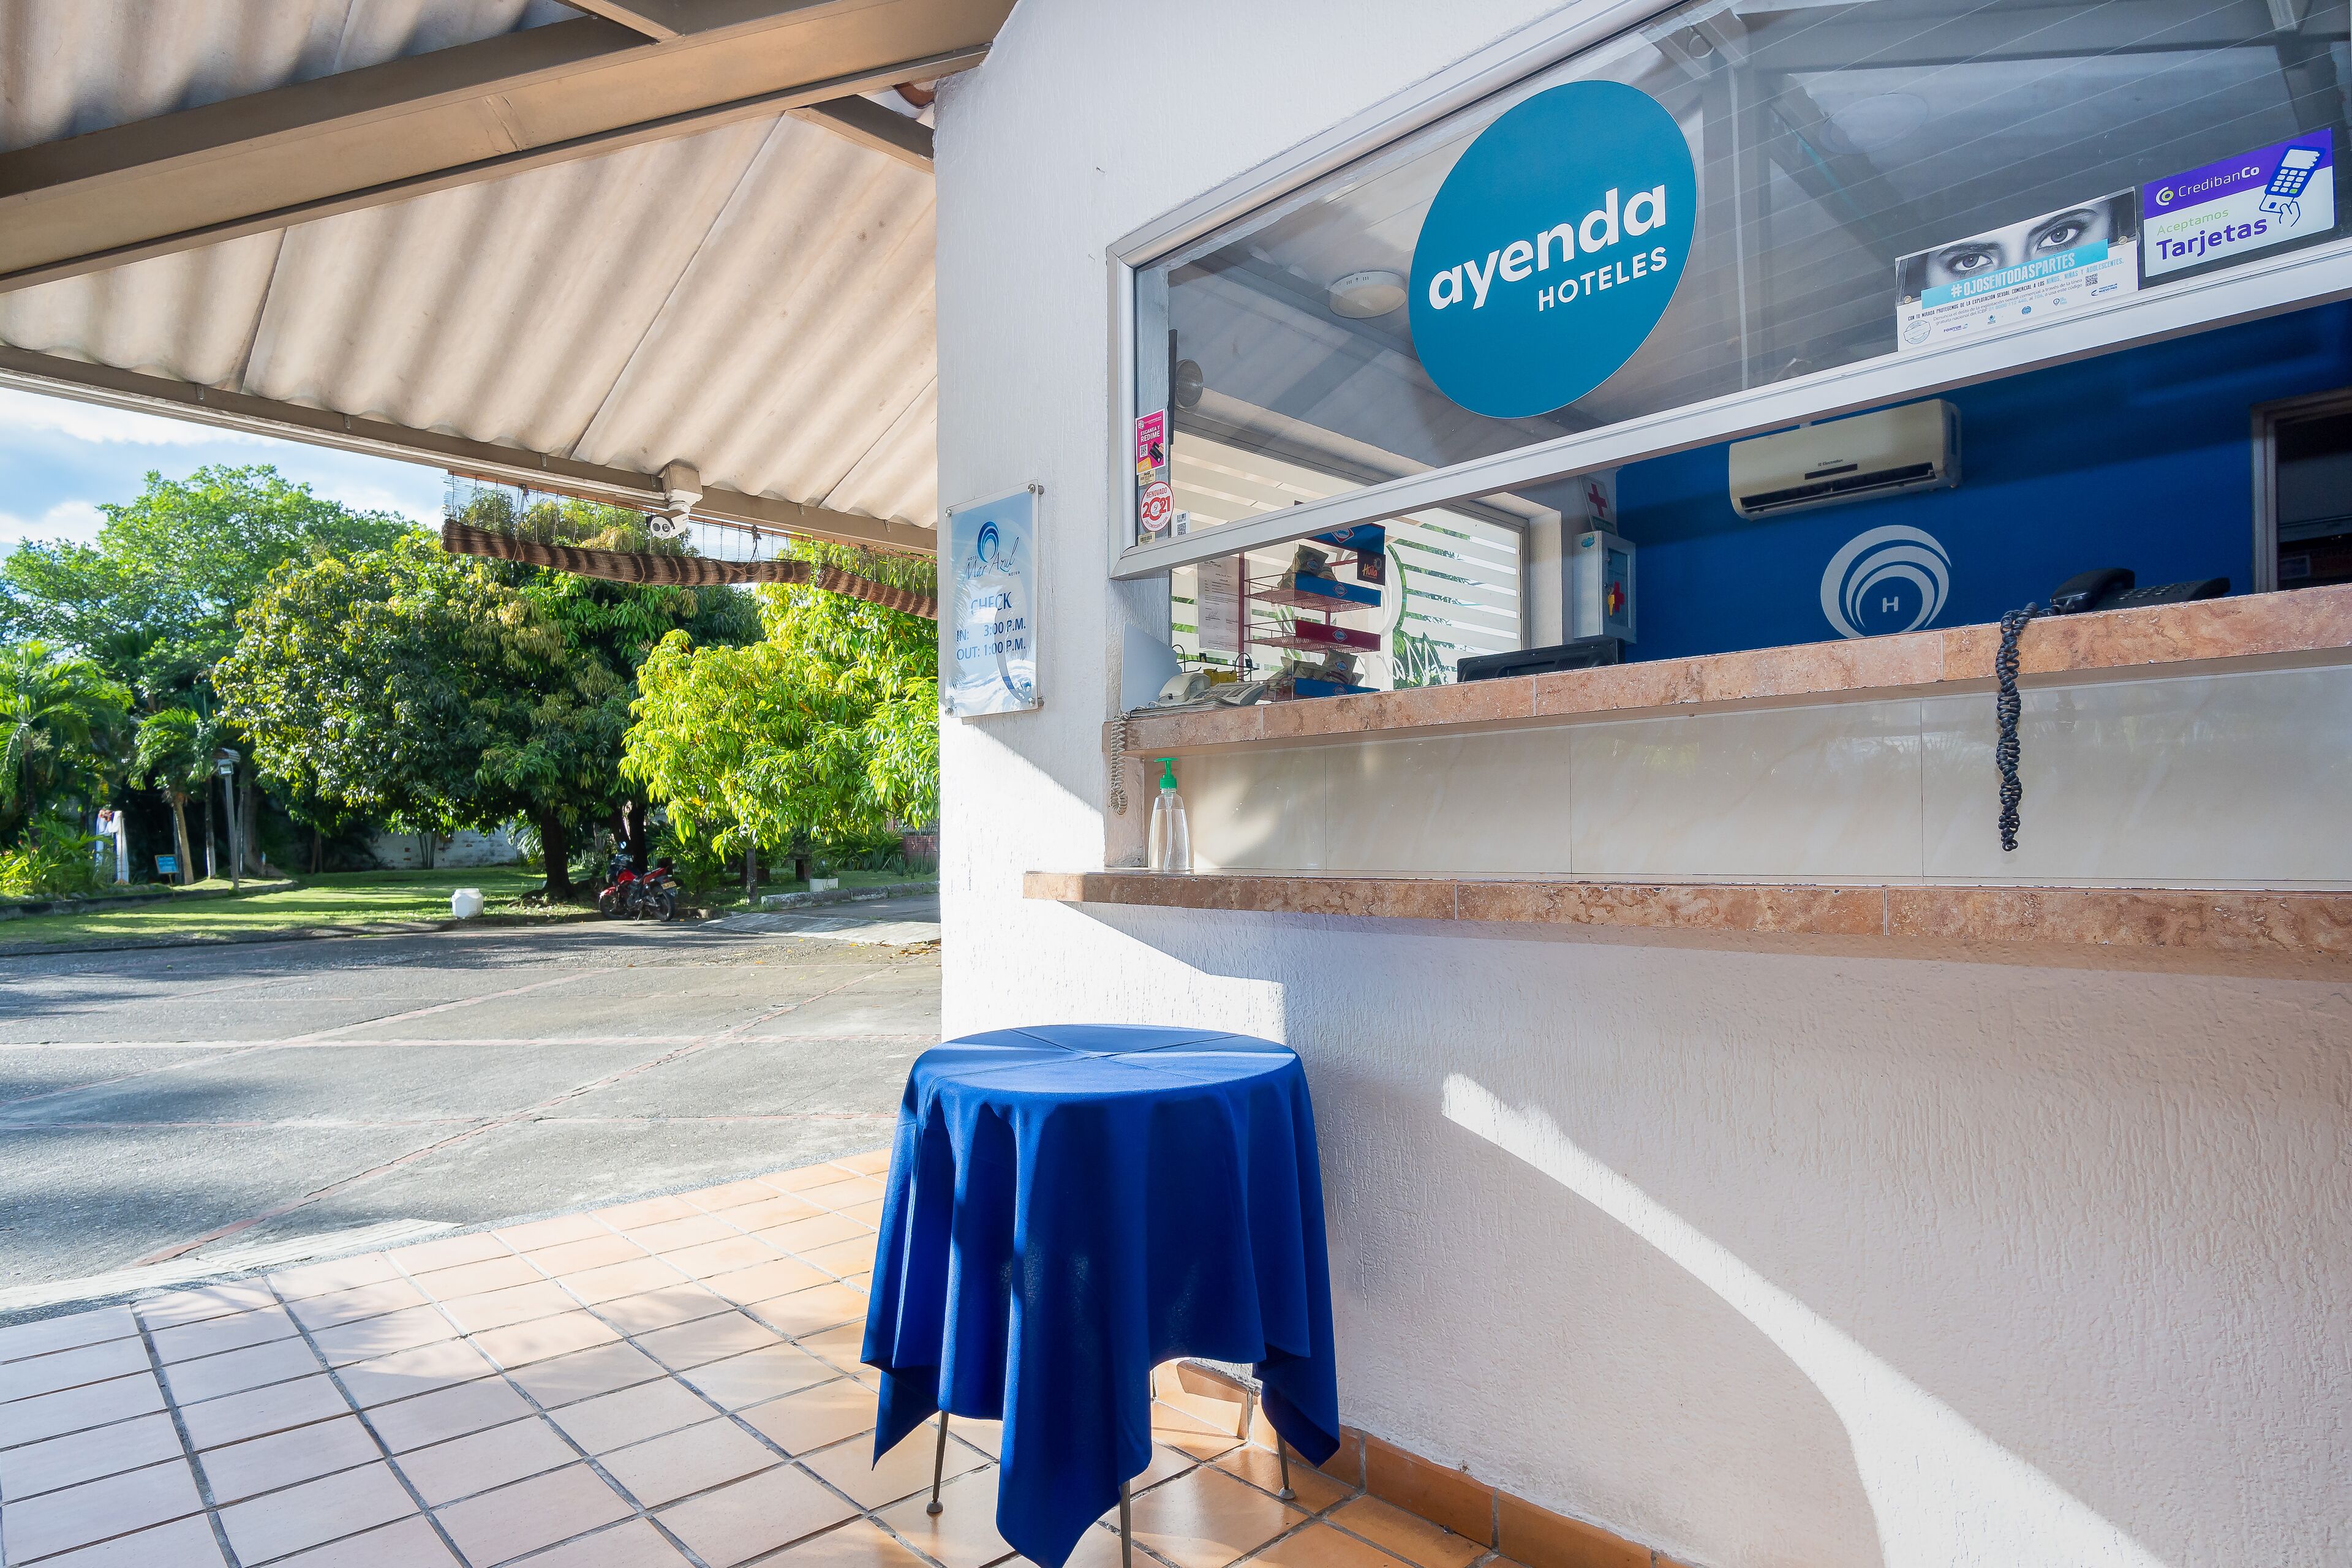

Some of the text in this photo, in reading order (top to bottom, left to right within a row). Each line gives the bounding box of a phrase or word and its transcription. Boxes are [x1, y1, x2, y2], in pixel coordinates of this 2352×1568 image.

[2178, 165, 2260, 197] CredibanCo
[2157, 209, 2229, 236] Aceptamos
[1428, 184, 1667, 310] ayenda
[2156, 219, 2267, 260] Tarjetas
[1538, 247, 1668, 312] HOTELES
[1951, 252, 2075, 298] #OJOSENTODASPARTES
[1936, 304, 1959, 314] PROTEGEMOS
[2011, 285, 2032, 294] COMERCIAL
[1140, 426, 1157, 436] ESCANEA
[1140, 430, 1161, 443] REDIME
[1146, 487, 1167, 499] RENOVADO
[962, 536, 1019, 582] Mar Azul
[970, 591, 1012, 615] CHECK
[1882, 596, 1899, 613] H
[956, 617, 1026, 642] IN: 3:00 P.M.
[956, 637, 1026, 660] OUT: 1:00 P.M.
